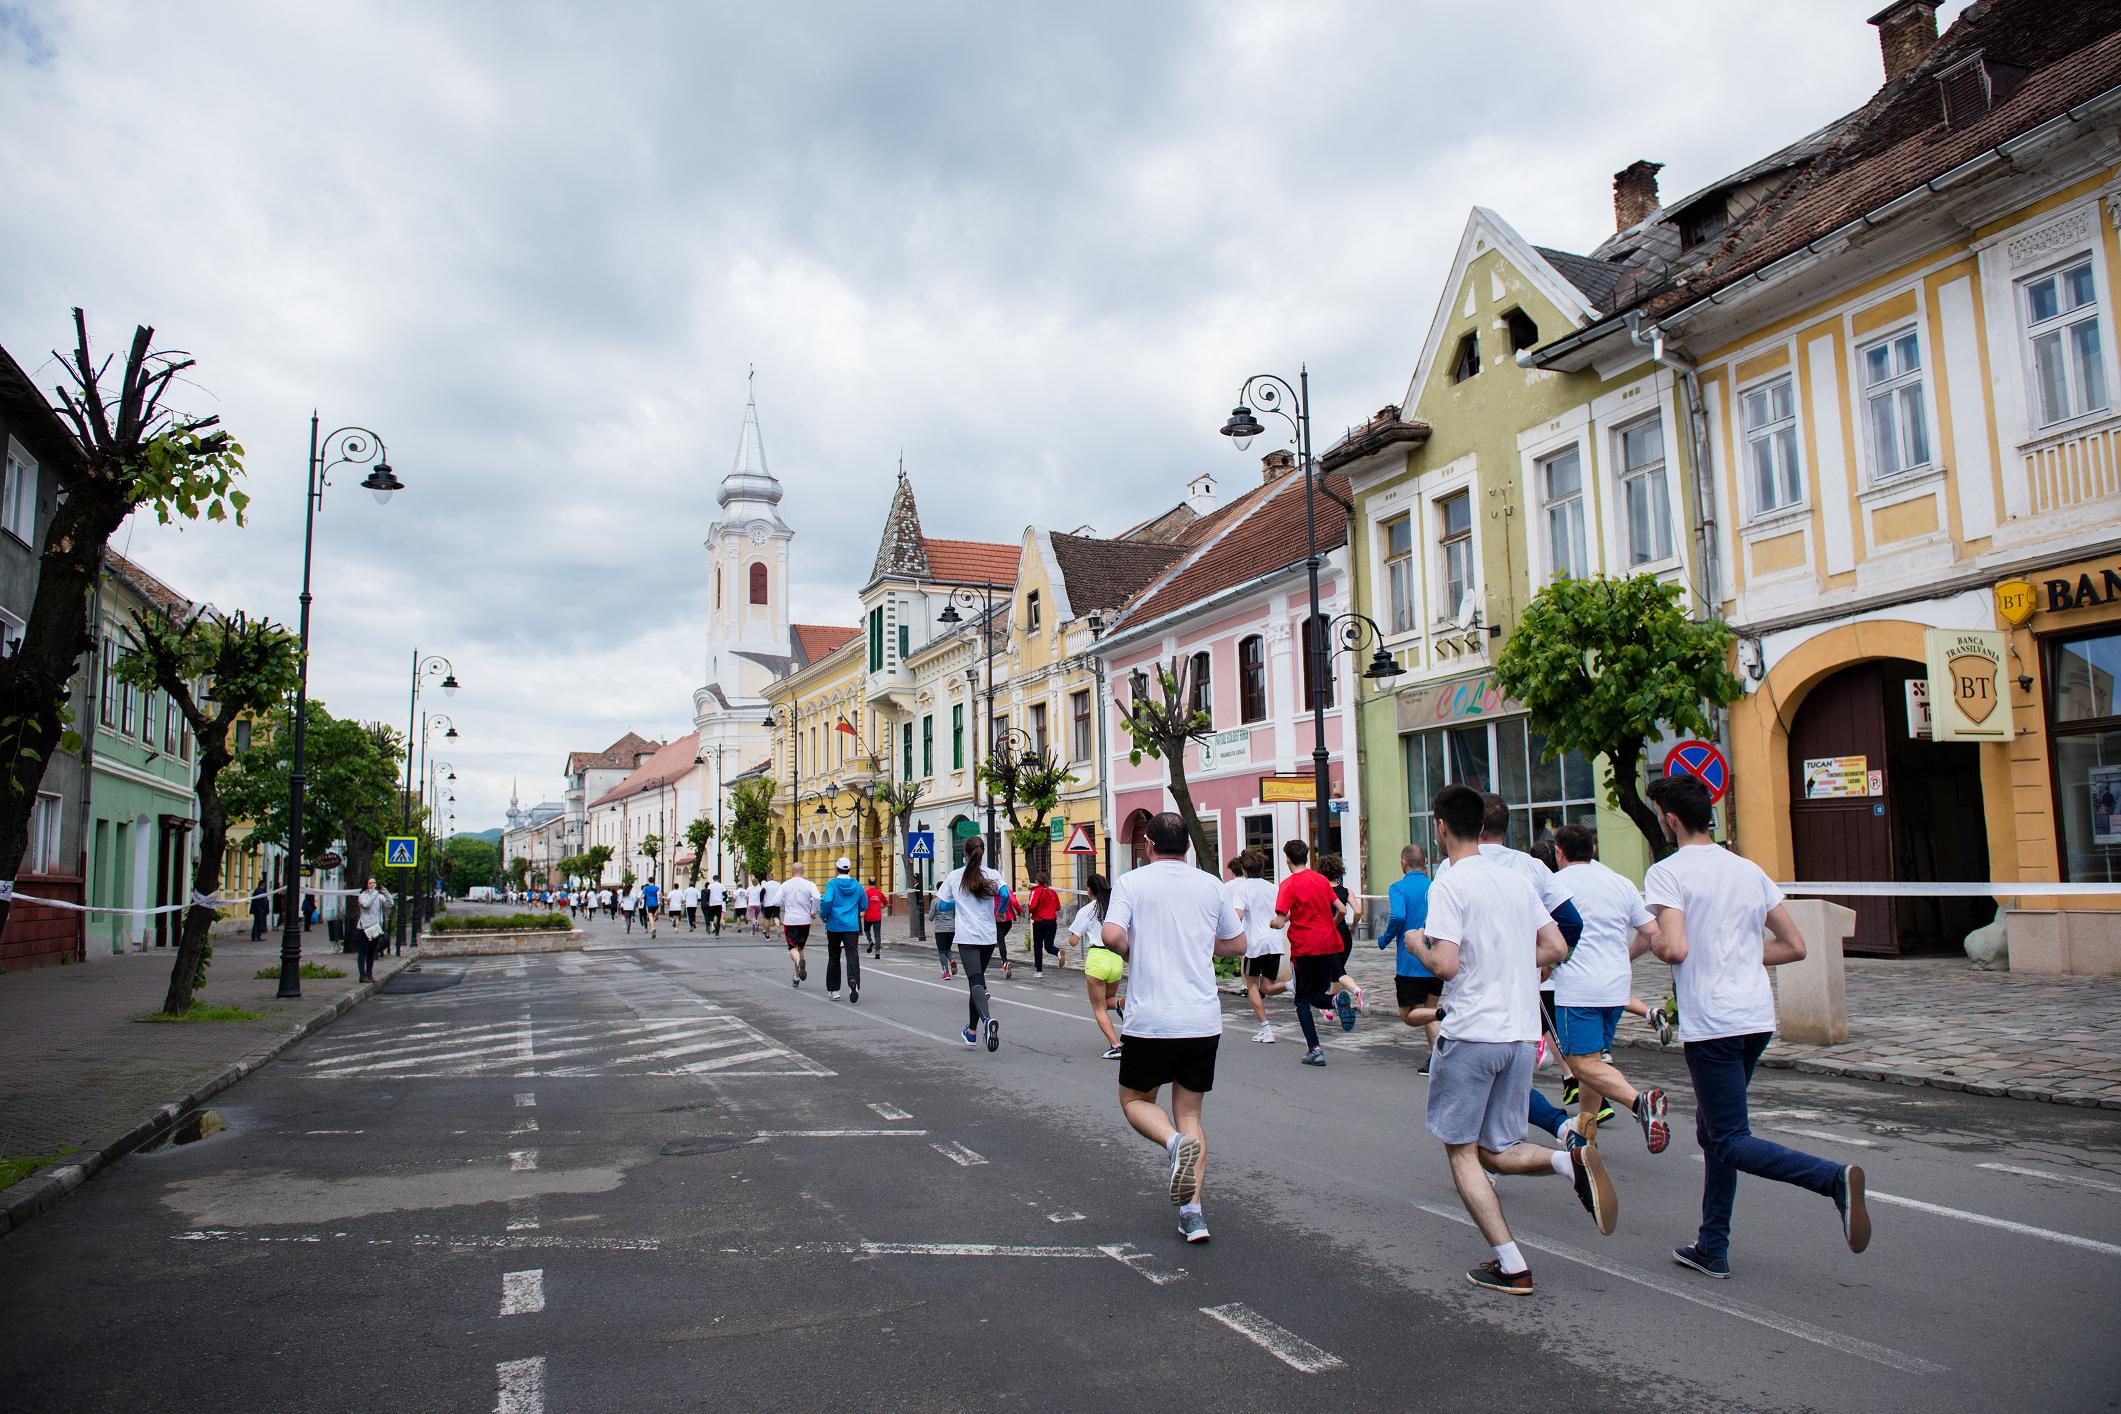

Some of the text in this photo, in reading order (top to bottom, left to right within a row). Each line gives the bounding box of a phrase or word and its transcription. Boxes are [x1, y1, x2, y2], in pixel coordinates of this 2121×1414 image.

[2003, 593, 2024, 609] BT
[1957, 636, 1984, 646] BANCA
[1946, 645, 2000, 662] TRANSILVANIA
[1960, 676, 1990, 699] BT
[1436, 680, 1506, 720] COLO
